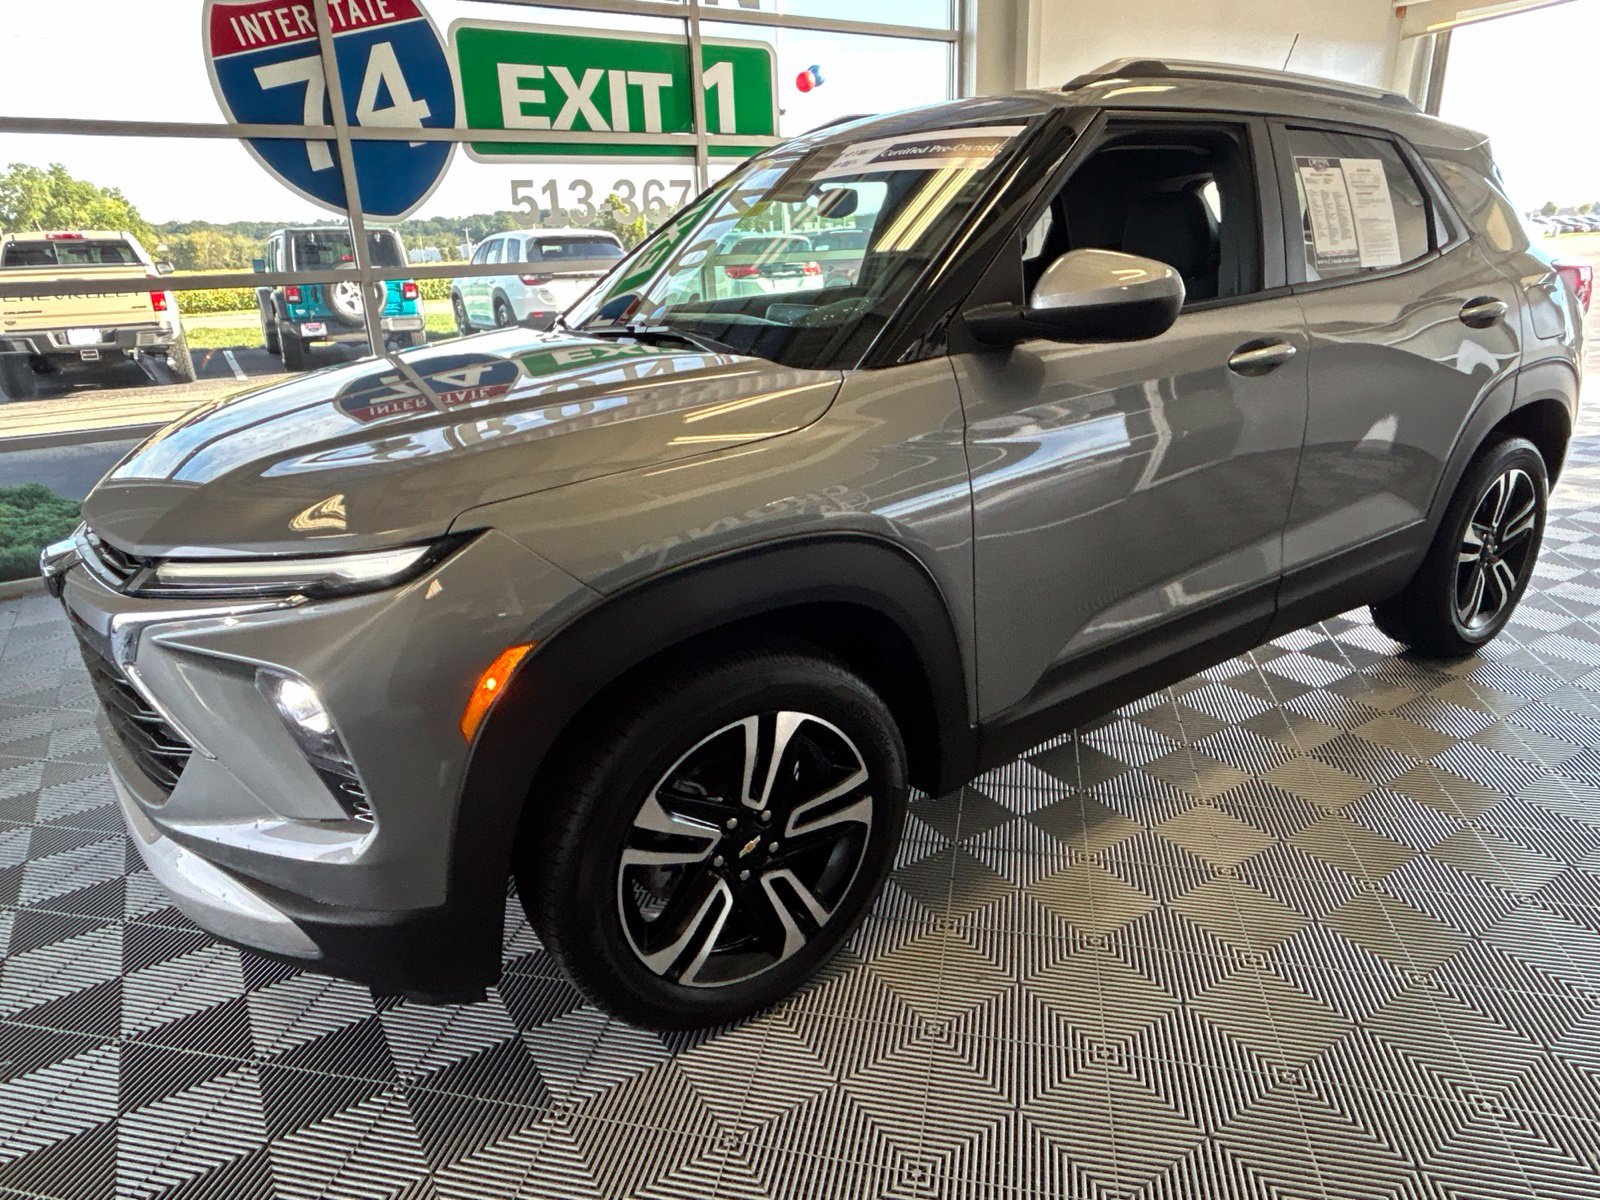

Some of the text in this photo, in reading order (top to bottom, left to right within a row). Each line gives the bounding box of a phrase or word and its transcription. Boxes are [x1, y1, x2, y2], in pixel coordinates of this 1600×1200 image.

[230, 0, 395, 46] INTERTATE
[253, 42, 431, 172] 74
[497, 61, 735, 133] EXIT 1
[880, 144, 929, 157] Certified
[929, 142, 999, 154] Pre-Owned
